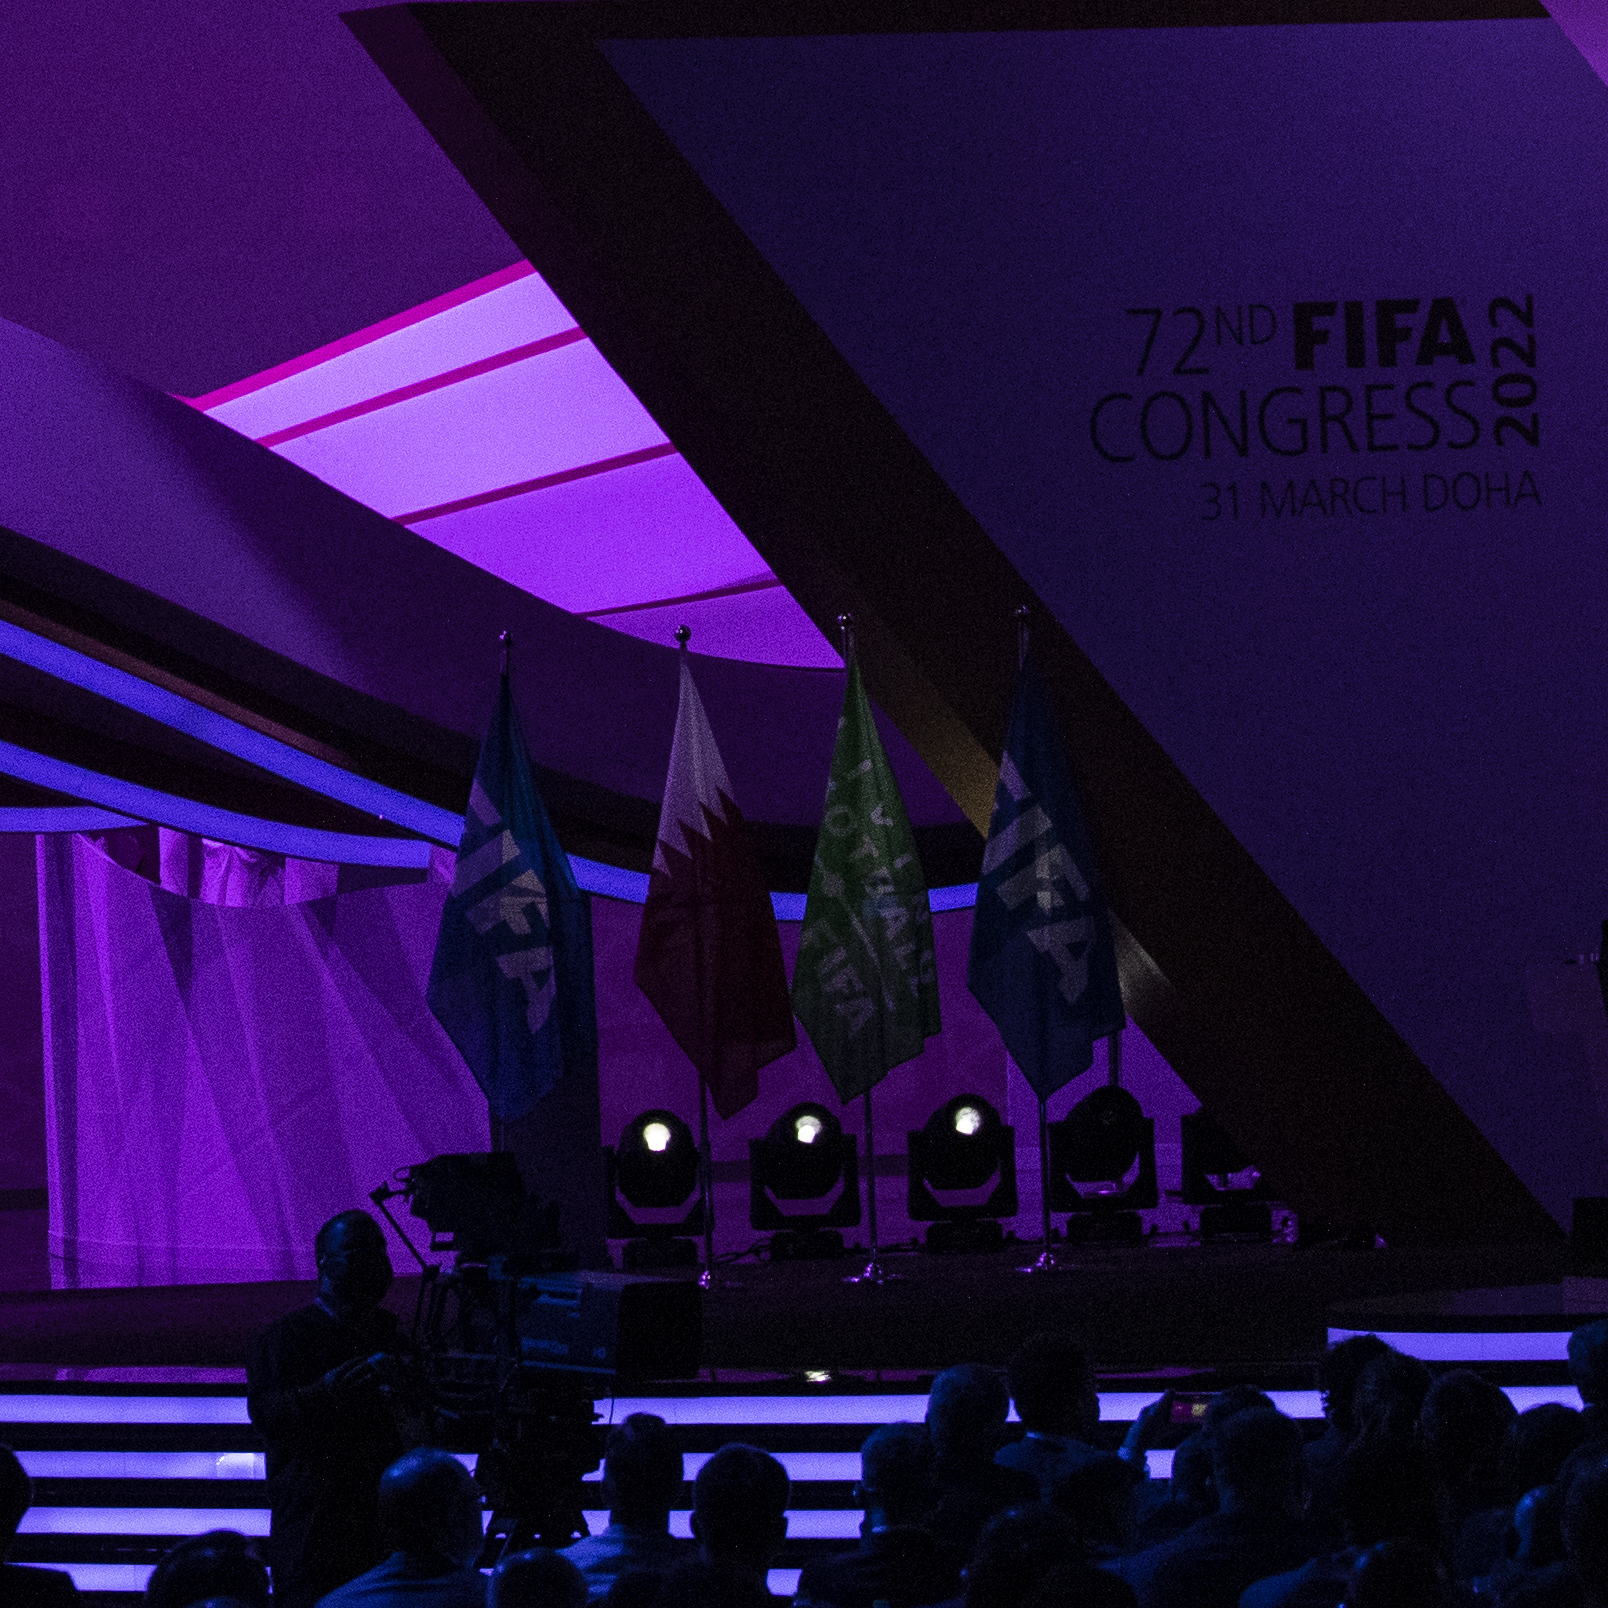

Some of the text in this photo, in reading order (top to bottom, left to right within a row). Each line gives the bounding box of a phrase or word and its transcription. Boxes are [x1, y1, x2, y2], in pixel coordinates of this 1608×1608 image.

[1125, 302, 1278, 376] 72ND
[1487, 293, 1541, 447] 2022
[1088, 380, 1482, 464] CONGRESS
[1200, 469, 1543, 522] 31 MARCH DOHA
